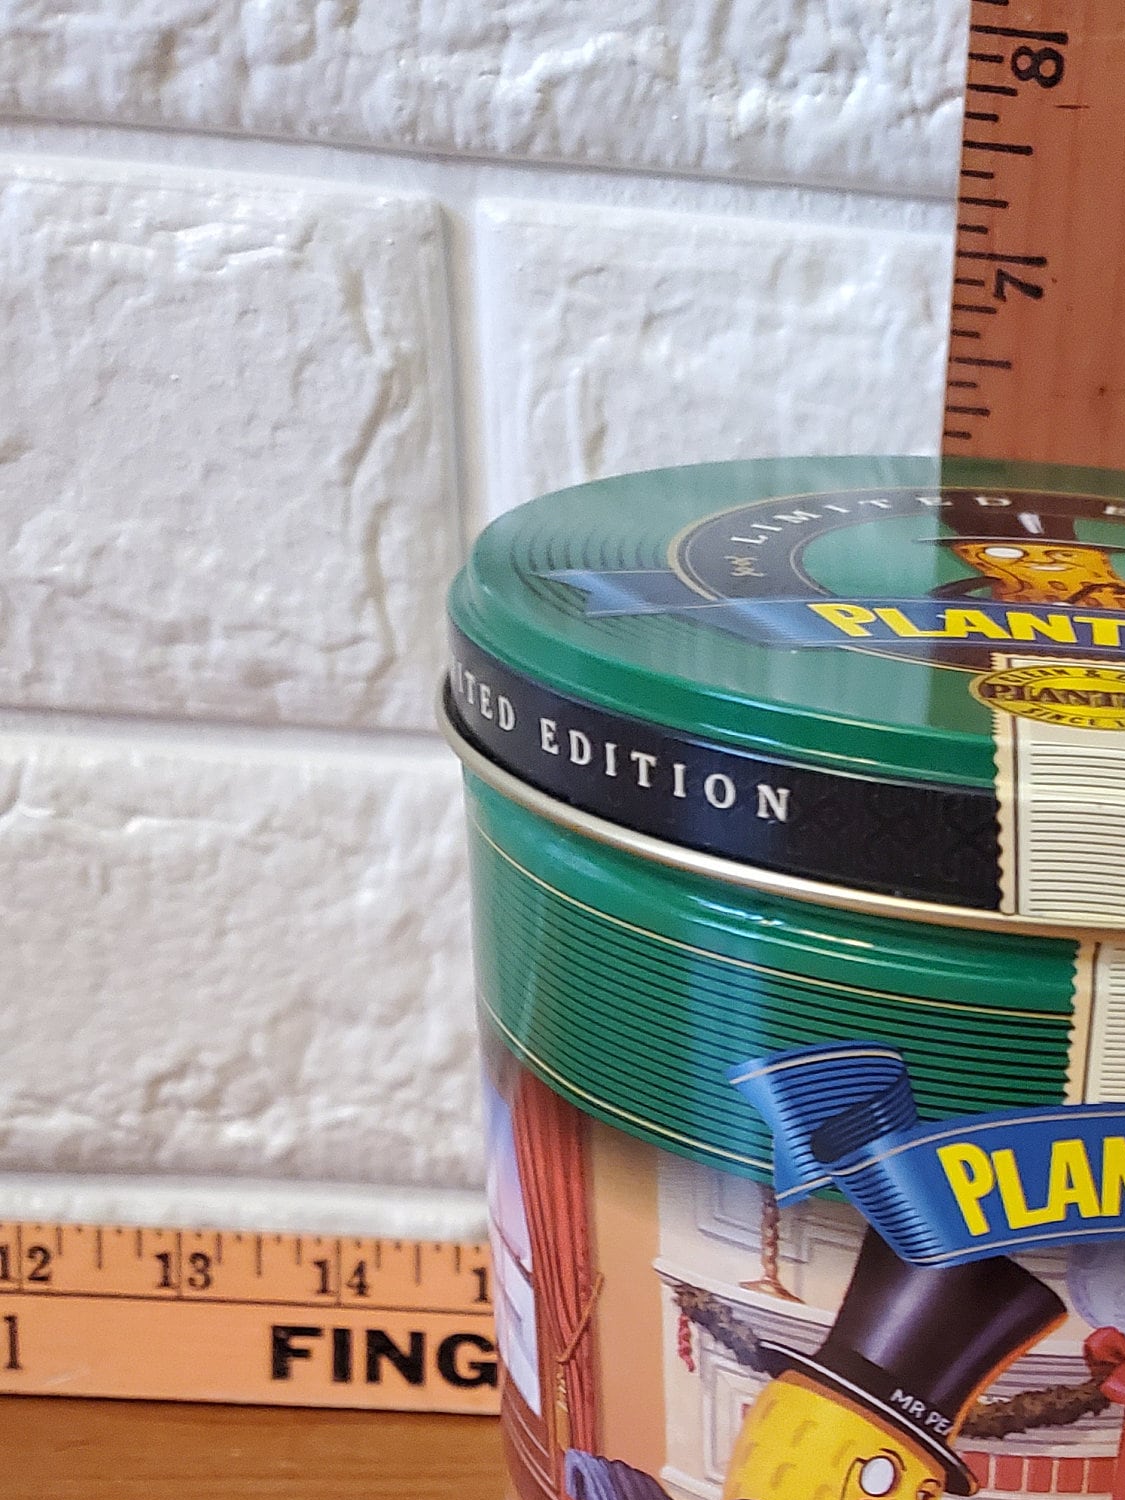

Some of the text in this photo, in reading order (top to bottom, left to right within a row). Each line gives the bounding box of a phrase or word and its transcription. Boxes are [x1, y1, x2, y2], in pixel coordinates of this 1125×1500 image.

[1011, 46, 1064, 88] 8
[994, 268, 1044, 302] 7
[729, 496, 1012, 545] LIMITED
[451, 660, 791, 823] ITED EDITION
[155, 1251, 213, 1290] 13
[314, 1258, 370, 1297] 14
[271, 1325, 498, 1389] FING
[890, 1388, 926, 1418] MR
